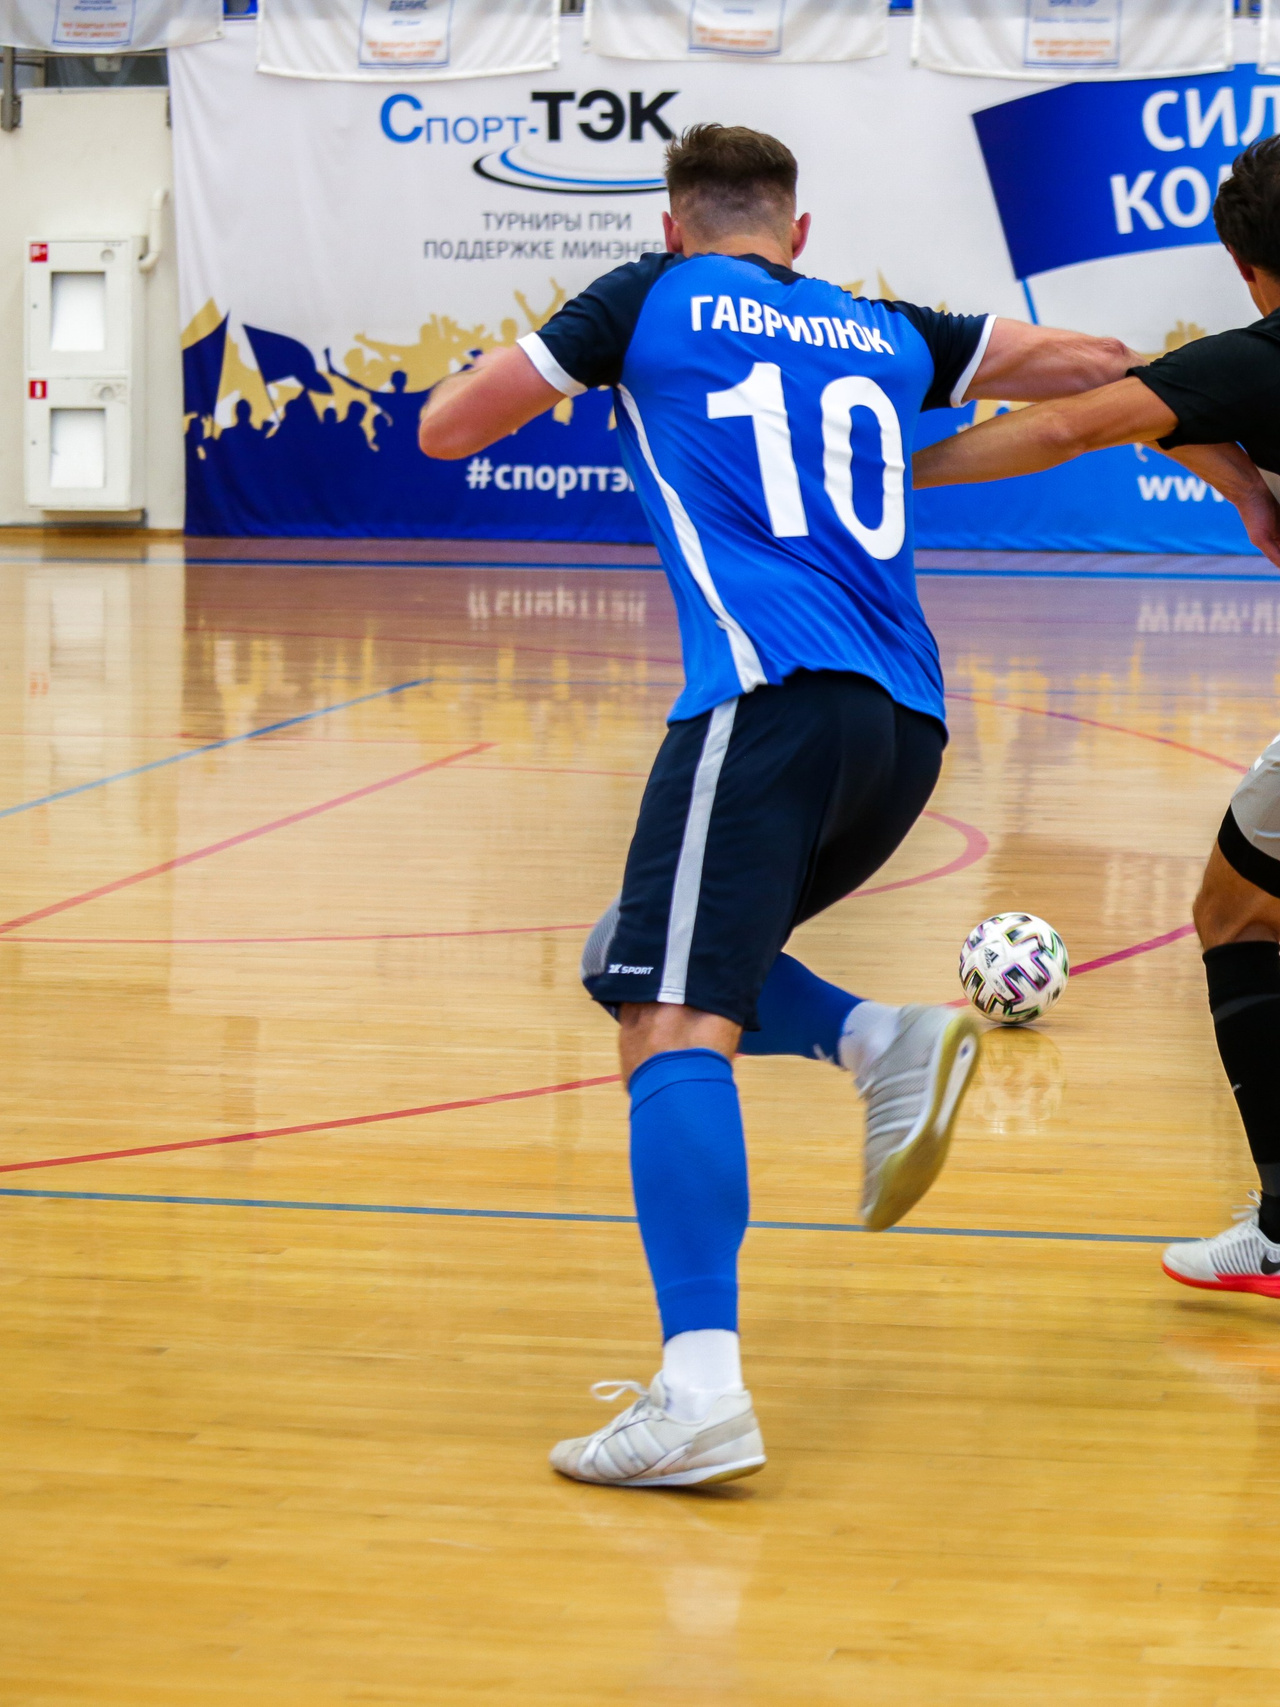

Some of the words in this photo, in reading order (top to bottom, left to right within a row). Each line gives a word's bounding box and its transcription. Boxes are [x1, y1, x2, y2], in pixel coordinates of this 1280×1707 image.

[481, 213, 582, 231] ТУРНИРЫ
[589, 213, 631, 231] ПРИ
[423, 241, 554, 260] ПОДДЕРЖКЕ
[691, 295, 895, 356] ГАВРИЛЮК
[706, 362, 906, 560] 10
[621, 966, 654, 975] SPORT
